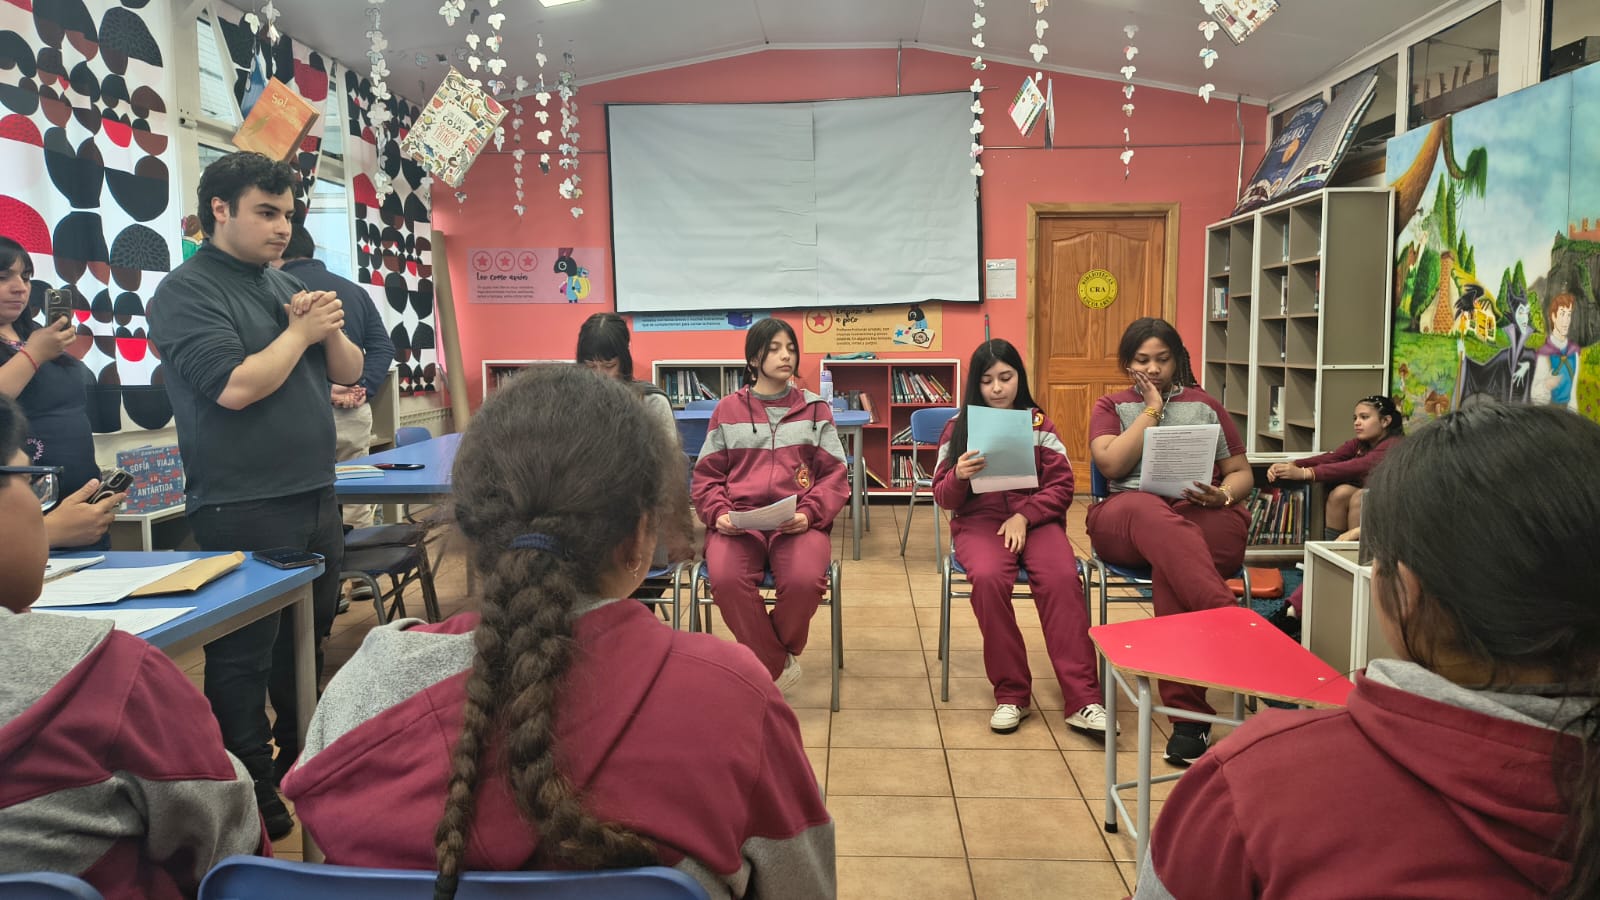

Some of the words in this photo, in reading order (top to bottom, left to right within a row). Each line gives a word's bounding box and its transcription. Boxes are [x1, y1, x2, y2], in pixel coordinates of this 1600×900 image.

[442, 115, 466, 135] COSAS
[130, 461, 149, 473] SOFÍA
[156, 458, 175, 468] VIAJA
[138, 483, 173, 496] ANTÁRTIDA
